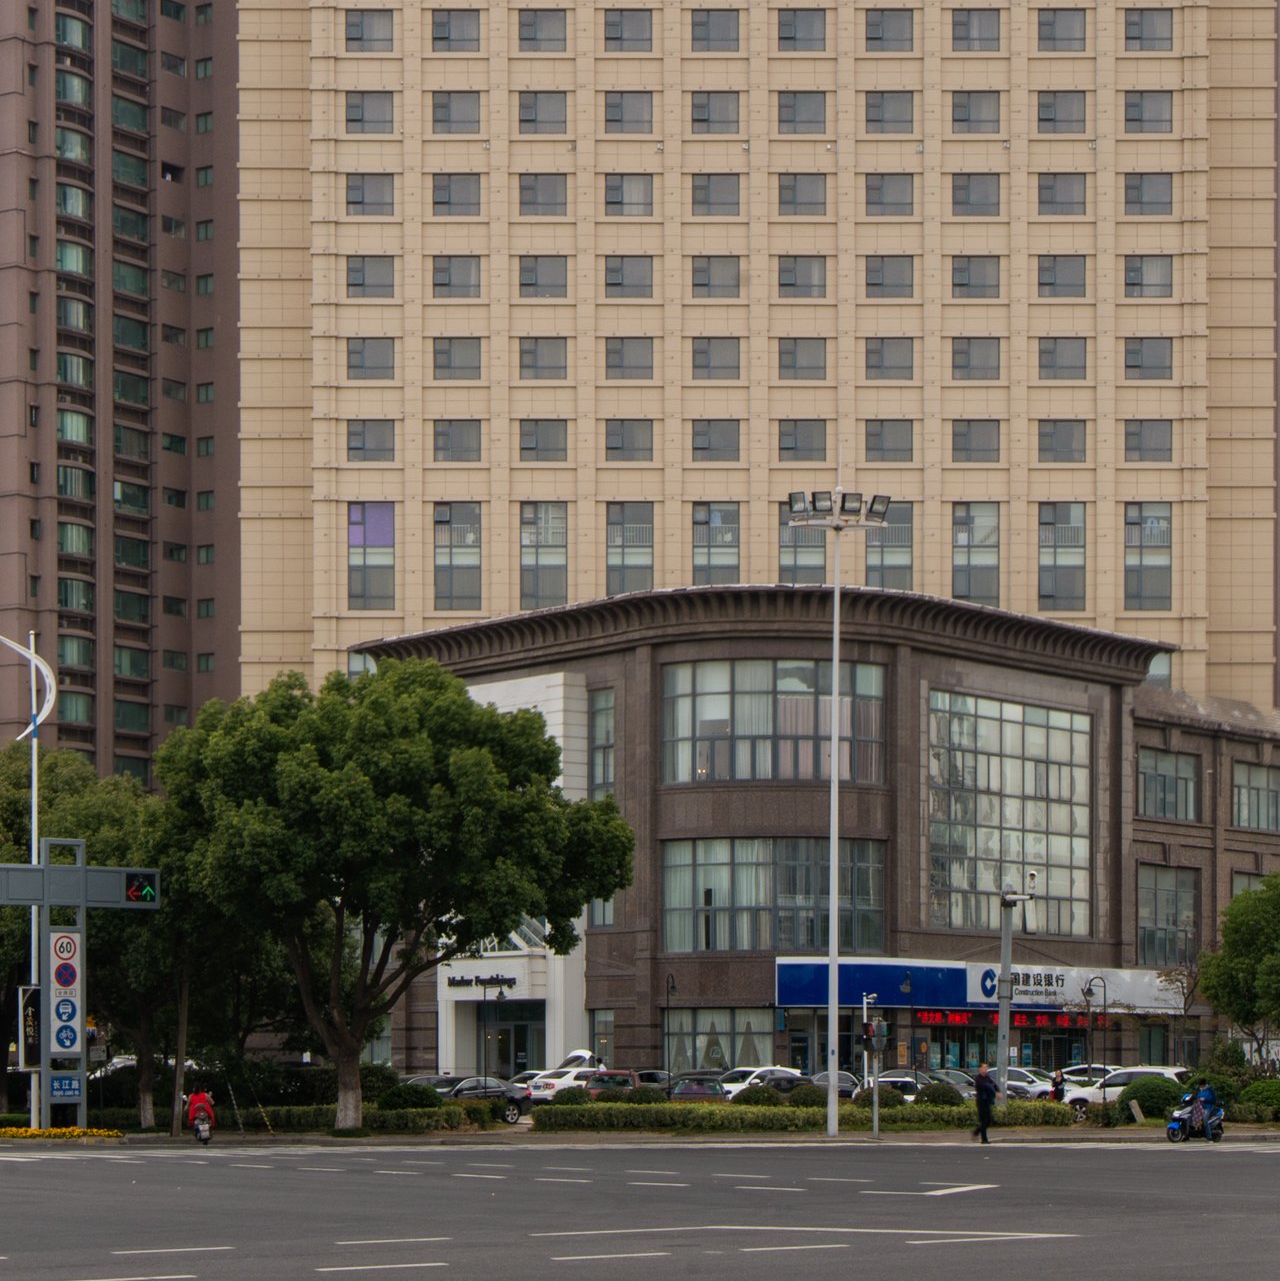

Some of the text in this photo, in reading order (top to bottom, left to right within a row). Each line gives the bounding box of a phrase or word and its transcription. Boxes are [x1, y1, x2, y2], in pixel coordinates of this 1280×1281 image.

[58, 941, 72, 954] 60
[1010, 972, 1065, 988] 国建设银行
[53, 1079, 79, 1090] 长江路
